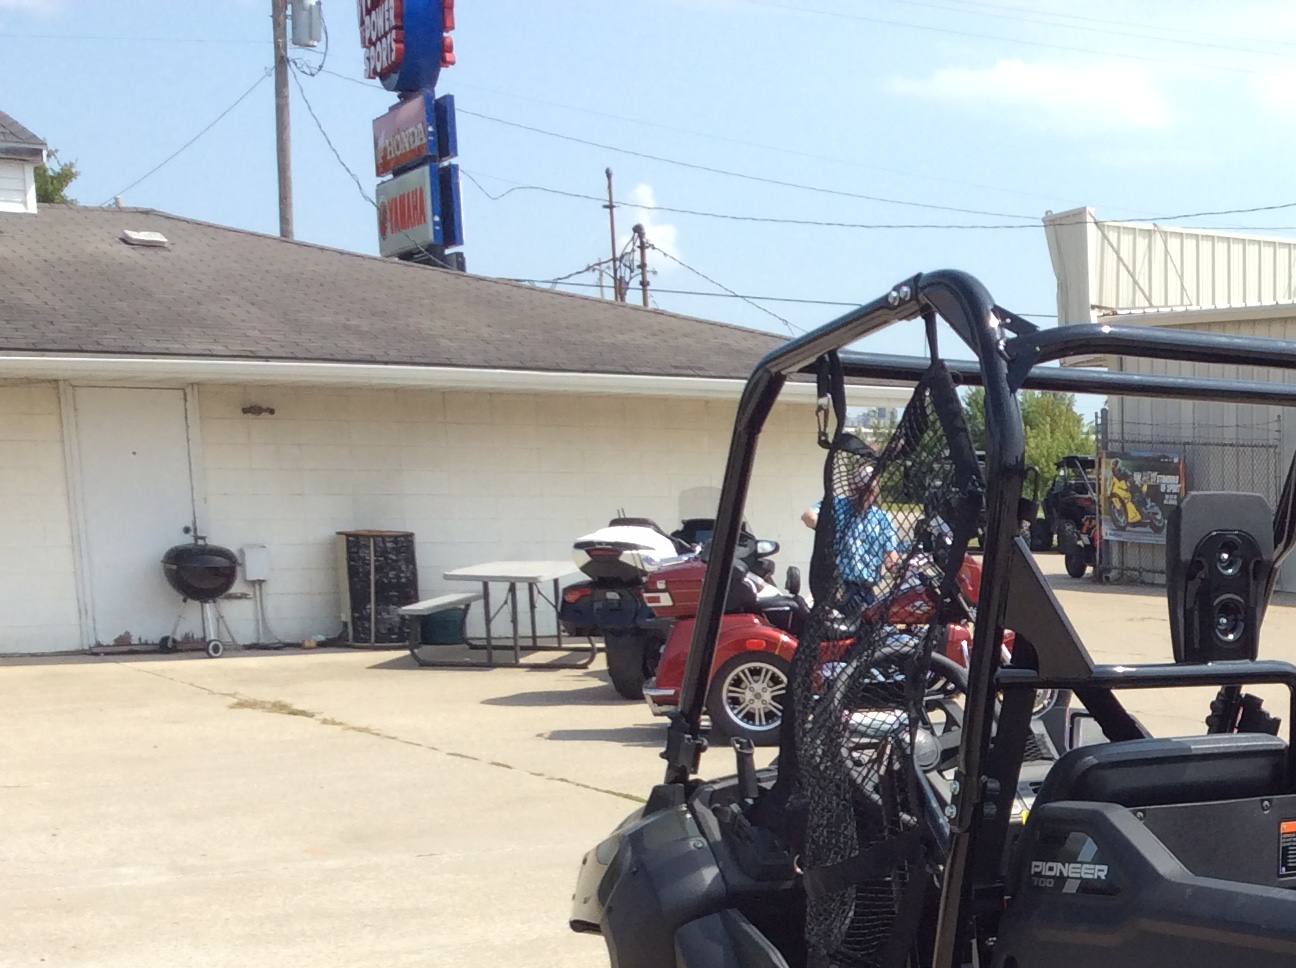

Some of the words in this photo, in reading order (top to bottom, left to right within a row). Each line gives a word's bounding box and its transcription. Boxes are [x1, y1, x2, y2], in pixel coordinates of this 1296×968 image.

[365, 0, 396, 46] POWER
[364, 29, 396, 79] SPORTS
[386, 122, 426, 160] HONDA
[388, 187, 427, 235] YAMAHA
[1031, 861, 1108, 880] PIONEER
[1031, 877, 1055, 888] 700
